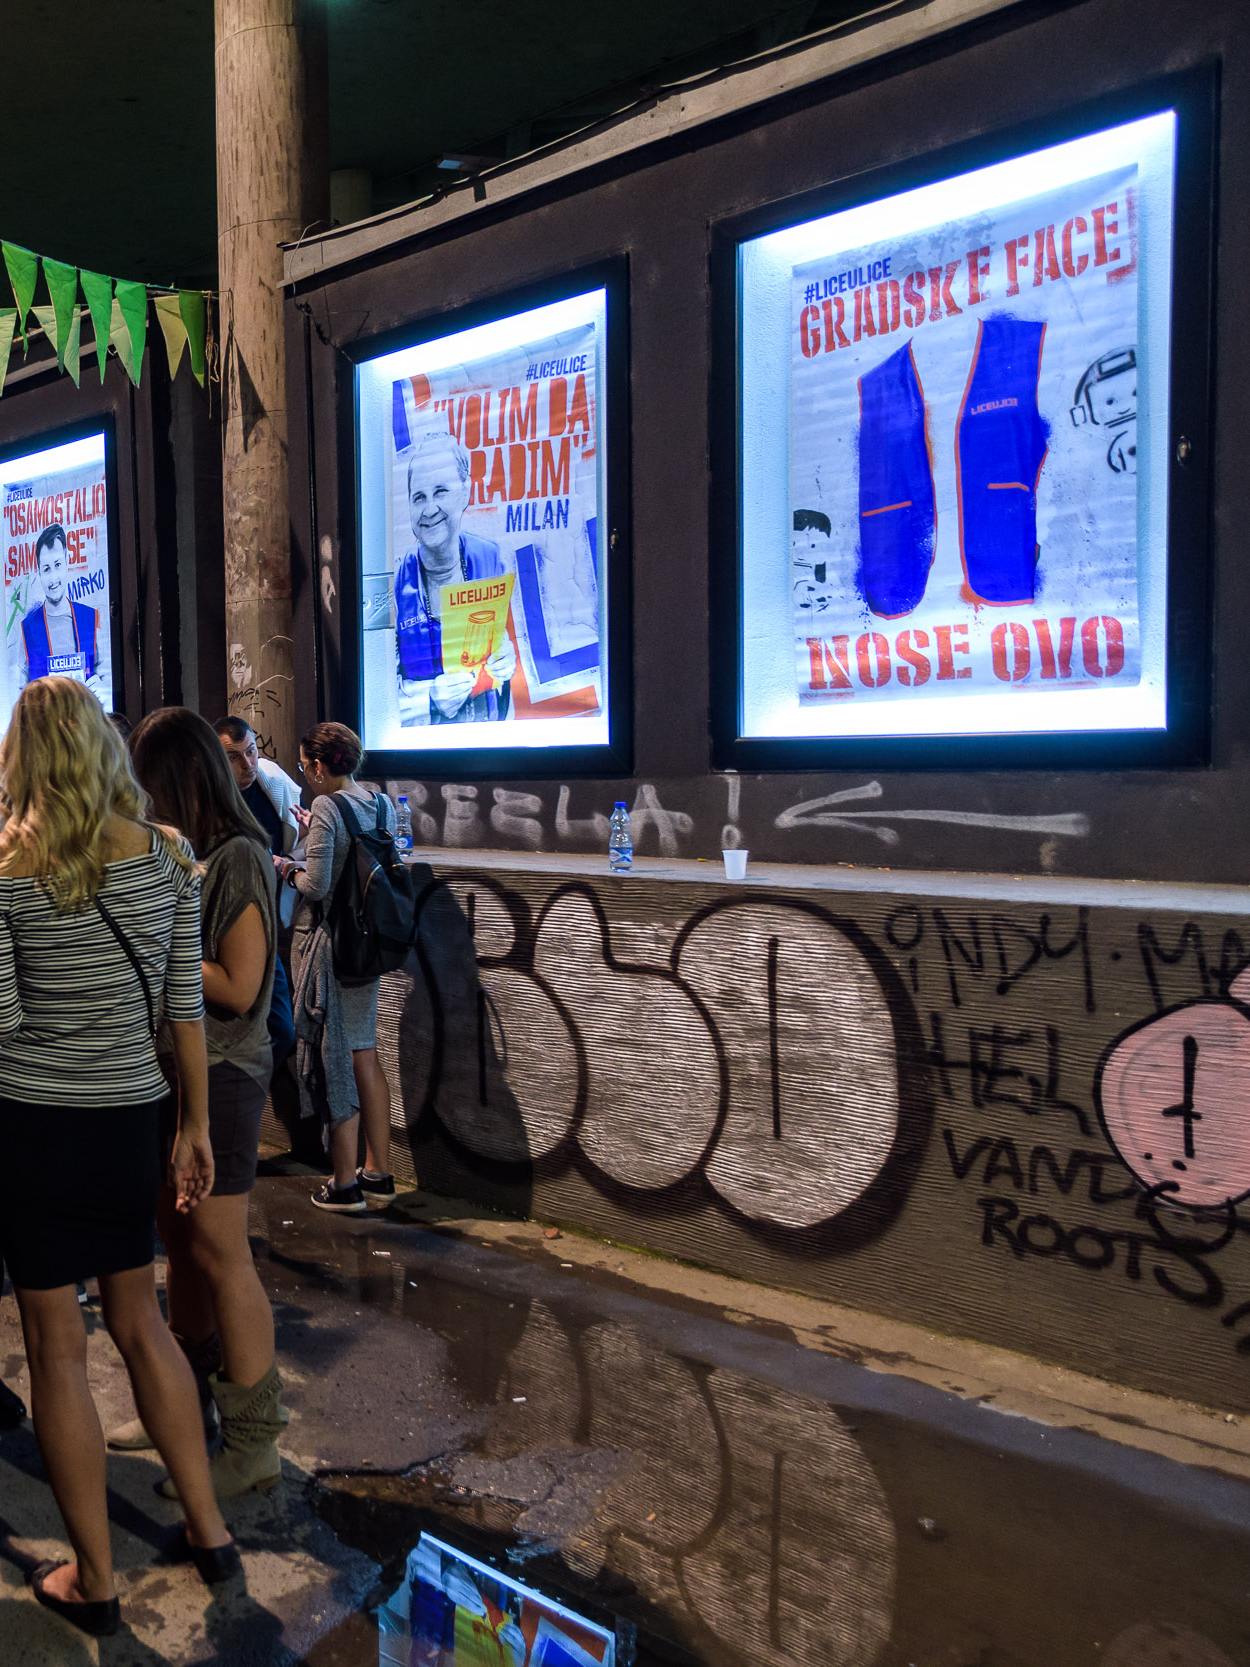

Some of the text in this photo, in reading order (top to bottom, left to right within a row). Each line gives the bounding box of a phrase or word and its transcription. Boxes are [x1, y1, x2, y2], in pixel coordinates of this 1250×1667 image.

[800, 202, 1121, 358] GRADSKE FACE
[804, 257, 892, 304] #LICEULICE
[526, 354, 587, 381] #LICEULICE
[548, 374, 590, 437] DA
[468, 433, 588, 506] RADIM"
[7, 487, 33, 503] #LICEULICE
[506, 498, 569, 533] MILAN
[8, 541, 38, 577] SAM
[806, 615, 1125, 690] NOSE OVO
